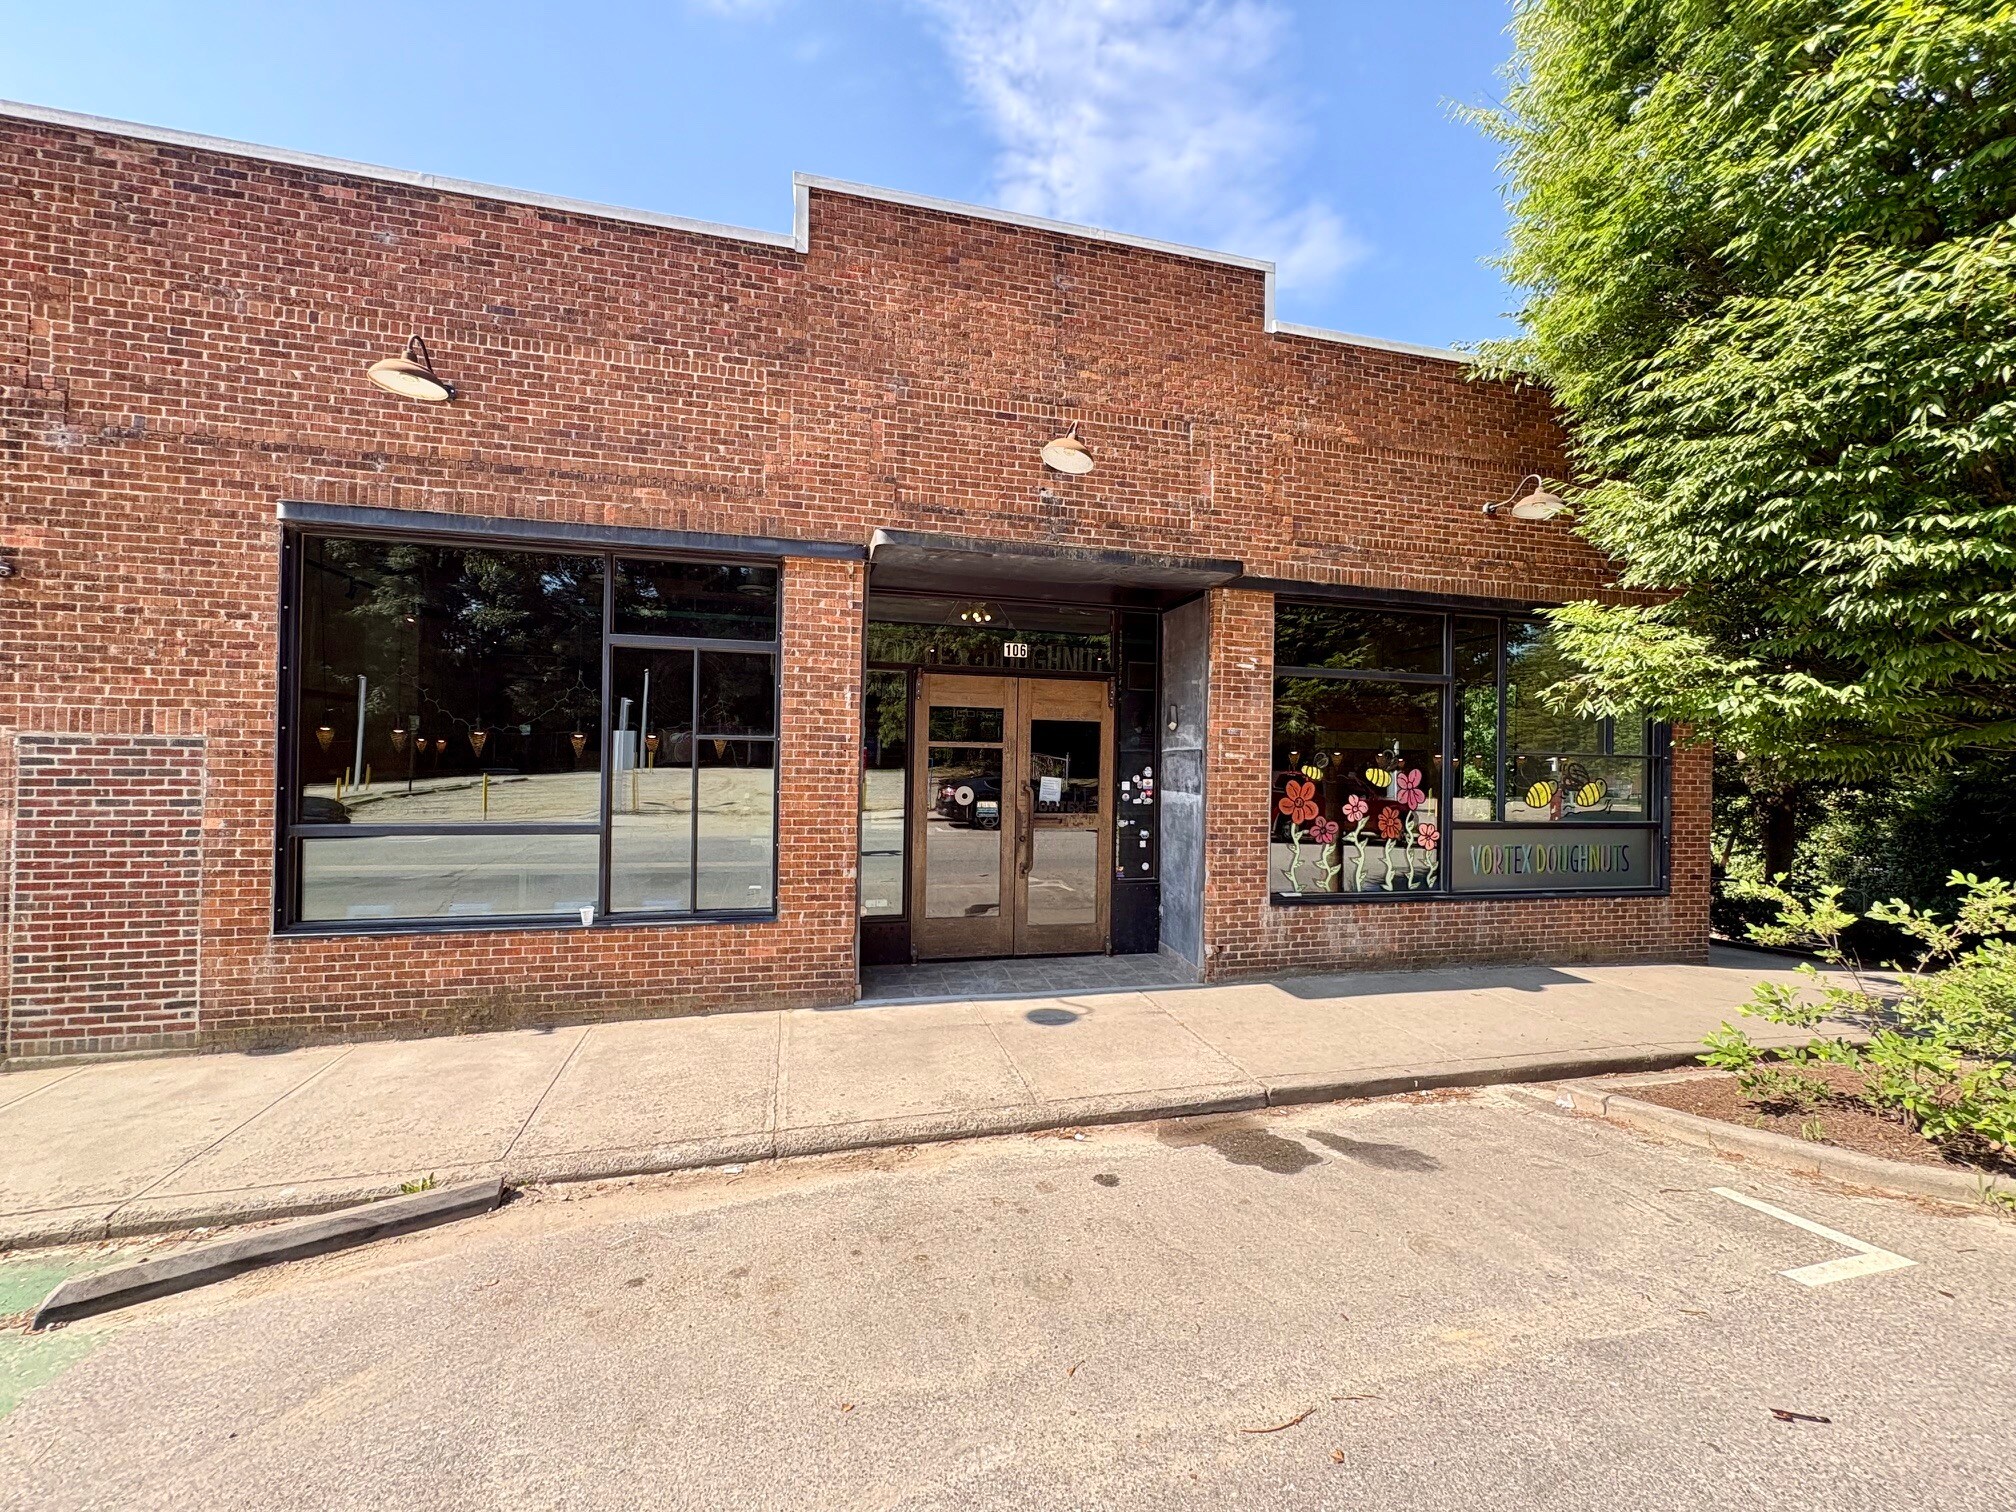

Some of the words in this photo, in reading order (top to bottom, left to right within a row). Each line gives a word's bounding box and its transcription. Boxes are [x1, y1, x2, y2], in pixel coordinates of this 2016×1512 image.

[1006, 644, 1026, 657] 106
[1470, 844, 1533, 876] VORTEX
[1536, 844, 1630, 875] DOUGHNUTS
